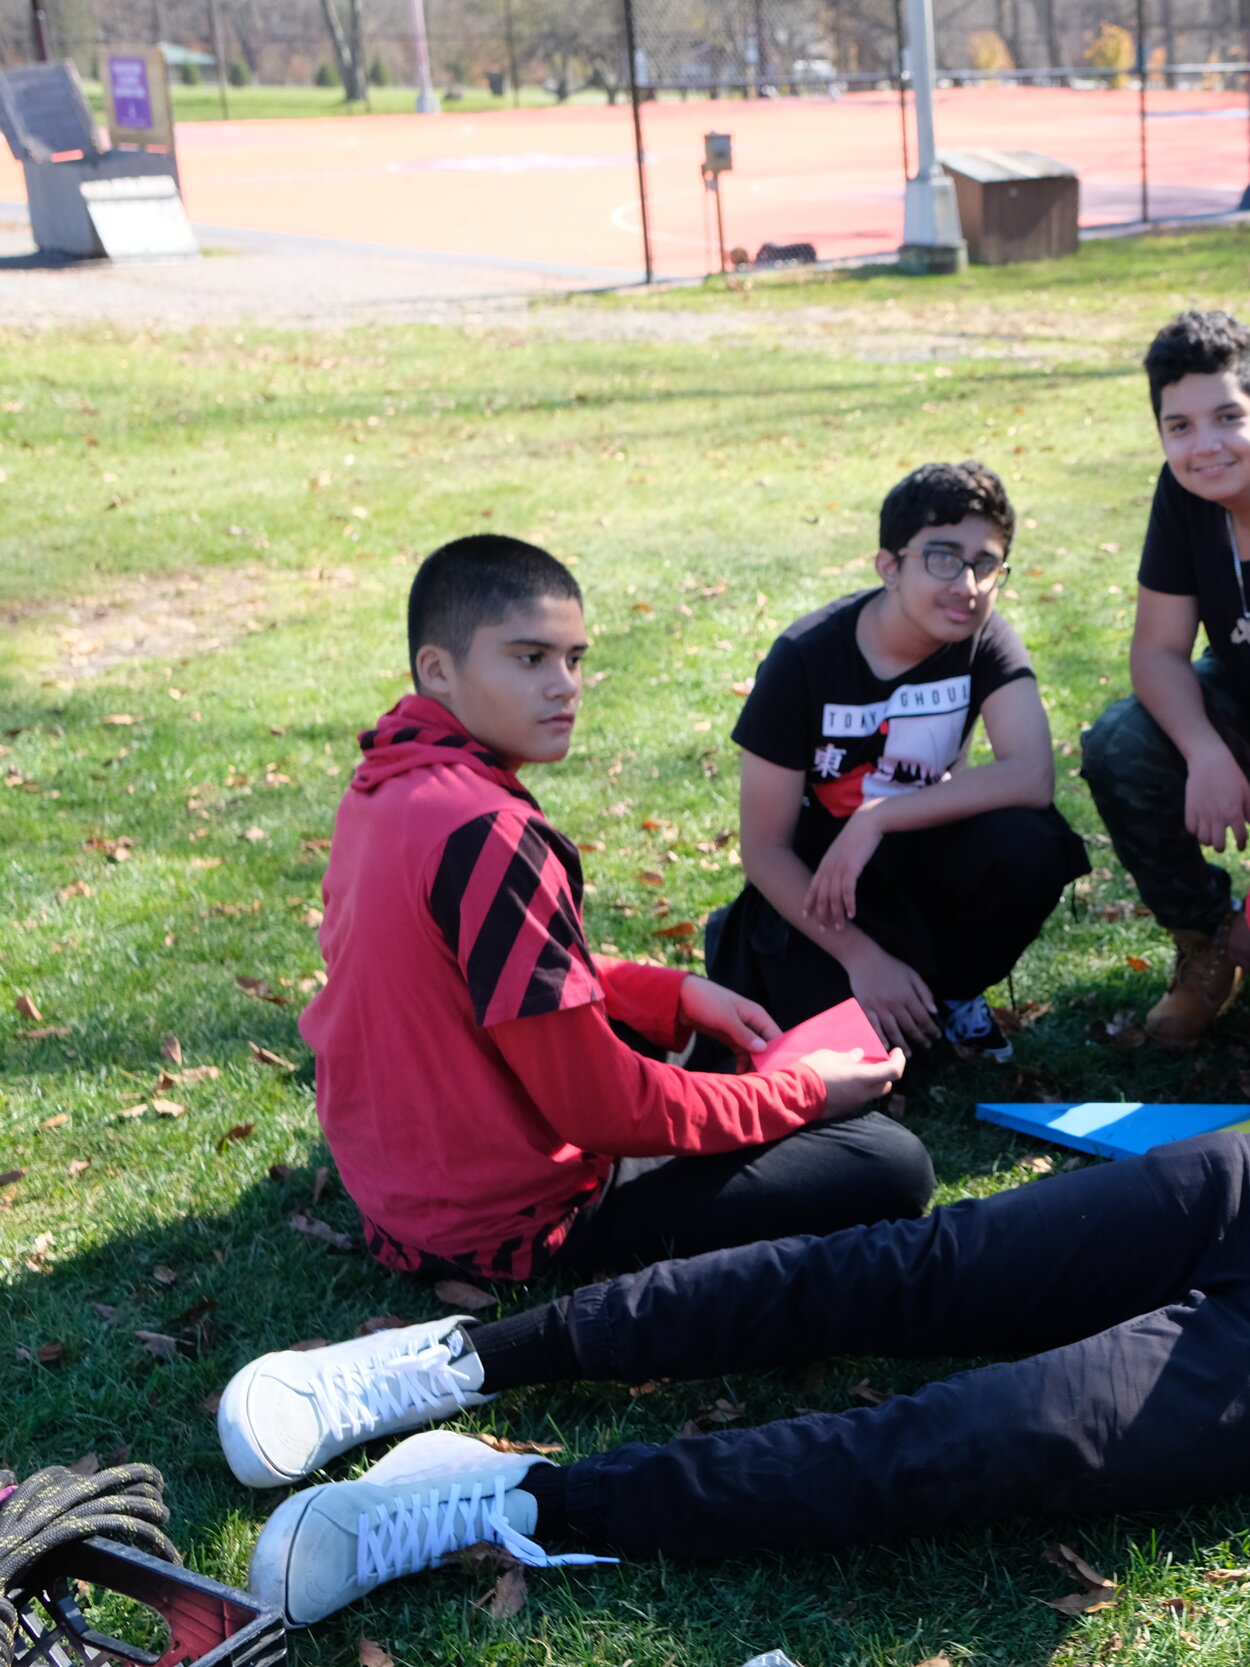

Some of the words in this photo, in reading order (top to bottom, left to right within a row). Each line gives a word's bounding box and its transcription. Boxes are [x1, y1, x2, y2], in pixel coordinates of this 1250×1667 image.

[828, 709, 888, 726] TOY
[900, 683, 969, 707] GHOUL
[812, 743, 848, 778] 東
